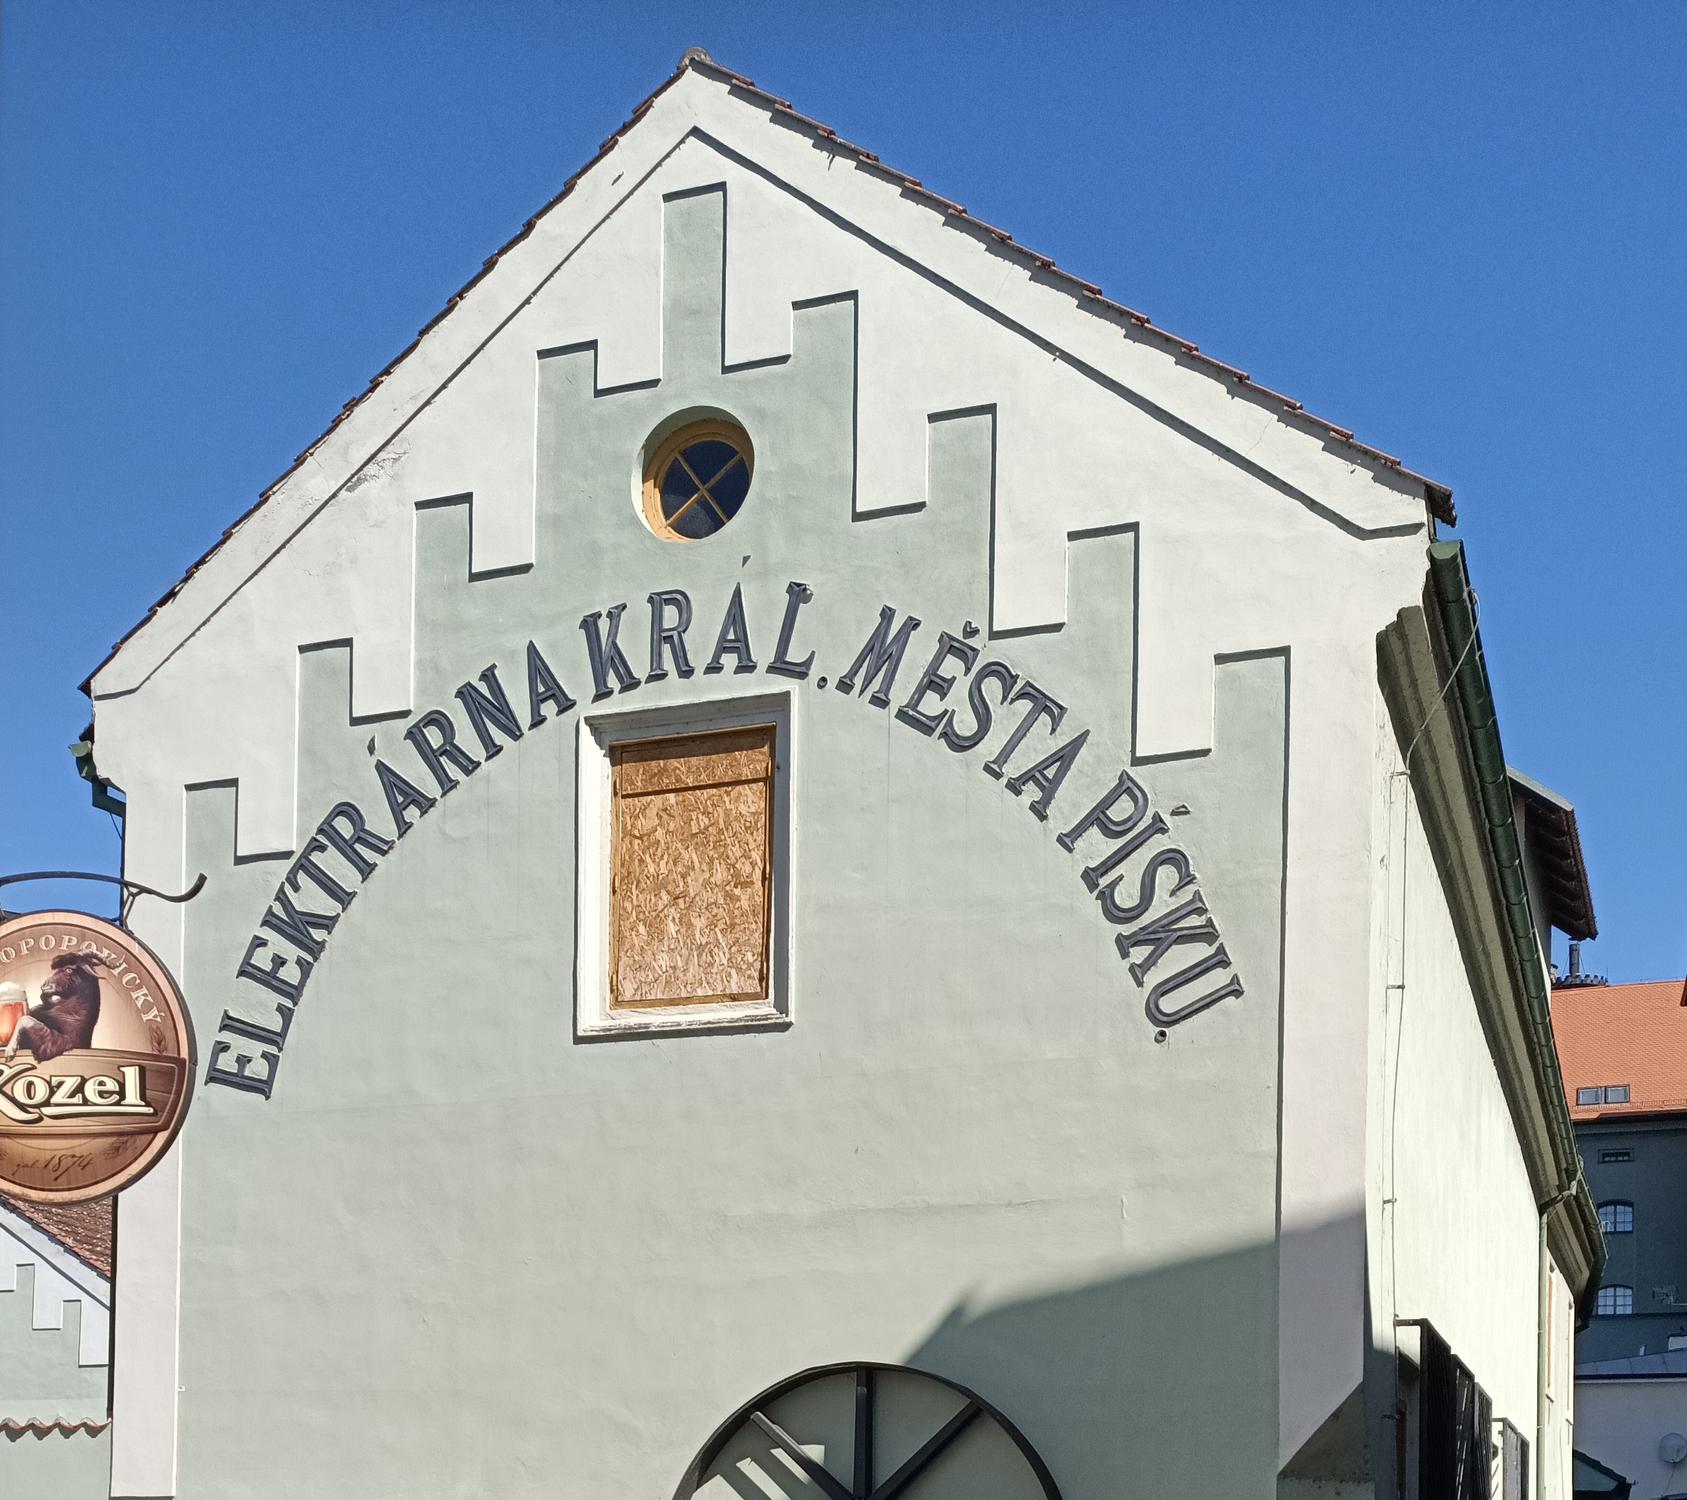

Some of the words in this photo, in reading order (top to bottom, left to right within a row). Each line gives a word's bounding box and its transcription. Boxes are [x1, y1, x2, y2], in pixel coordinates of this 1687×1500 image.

[205, 640, 576, 1100] ELEKTRÁRNA
[836, 604, 1091, 822] MĚSTA
[43, 1152, 94, 1181] 1874
